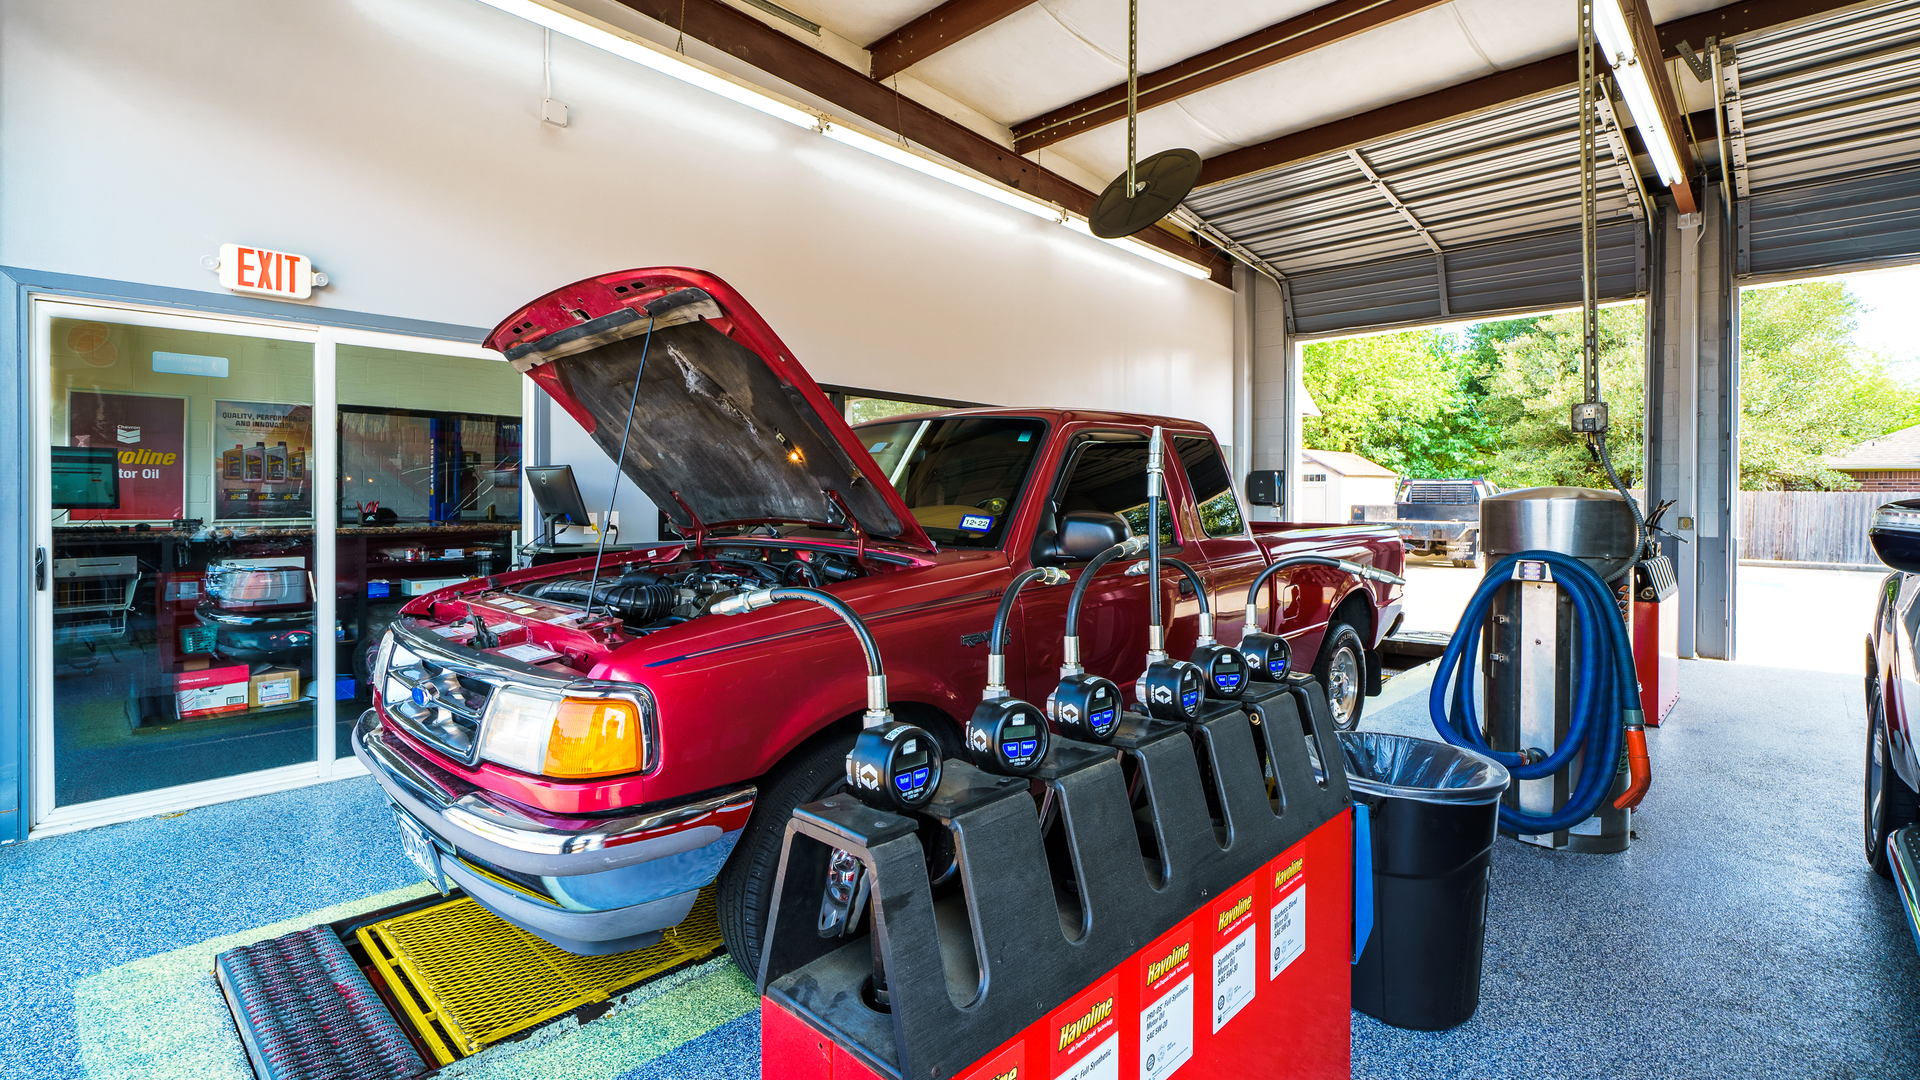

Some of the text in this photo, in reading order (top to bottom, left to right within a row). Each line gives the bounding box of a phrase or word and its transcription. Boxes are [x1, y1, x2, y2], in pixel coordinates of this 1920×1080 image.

[238, 247, 300, 293] EXIT
[223, 412, 306, 422] QUALITY, PERFORMANCE
[118, 449, 176, 465] voline
[118, 468, 159, 479] tor Oil
[915, 772, 926, 780] Reset
[1275, 857, 1302, 890] Havoline
[1218, 894, 1252, 933] Havoline
[1146, 942, 1189, 987] Havoline
[1218, 938, 1246, 967] Synthetic Blend
[1217, 963, 1229, 977] Motor
[1164, 997, 1172, 1008] Full
[1172, 984, 1189, 1002] Synthetic
[1058, 996, 1113, 1053] Havoline
[1075, 1037, 1087, 1049] Deposit
[1097, 1018, 1113, 1033] Technology
[1146, 1017, 1158, 1031] Motor
[1146, 1029, 1155, 1042] SAE
[1080, 1049, 1112, 1079] Full Synthetic
